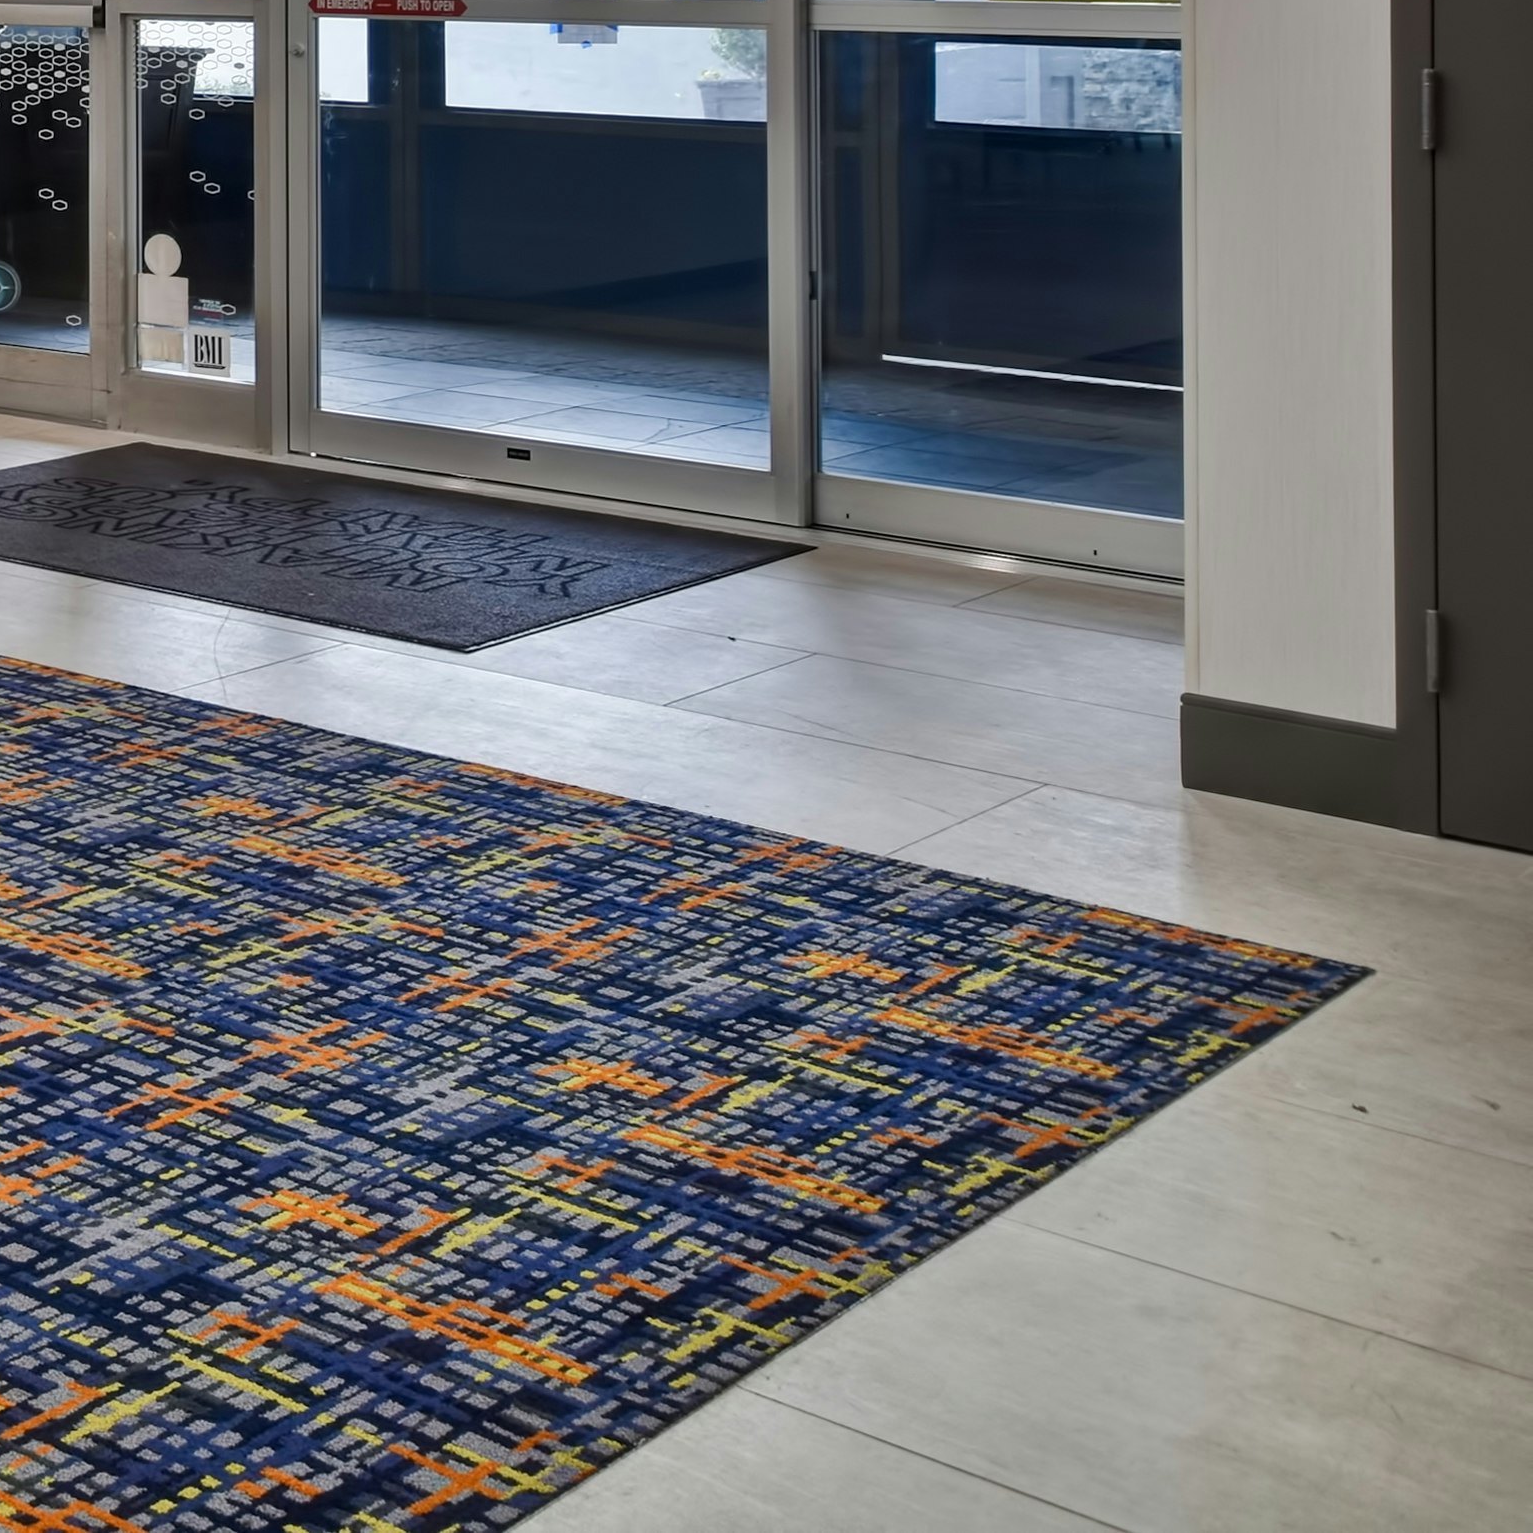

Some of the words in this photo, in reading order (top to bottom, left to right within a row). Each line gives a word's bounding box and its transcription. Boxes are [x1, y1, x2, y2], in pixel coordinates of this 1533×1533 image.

[397, 0, 418, 10] PUSH
[420, 0, 430, 11] TO
[433, 0, 455, 11] OPEN
[194, 334, 224, 366] BMI
[34, 477, 176, 511] US
[181, 503, 610, 577] MAKES
[319, 543, 578, 597] YOU
